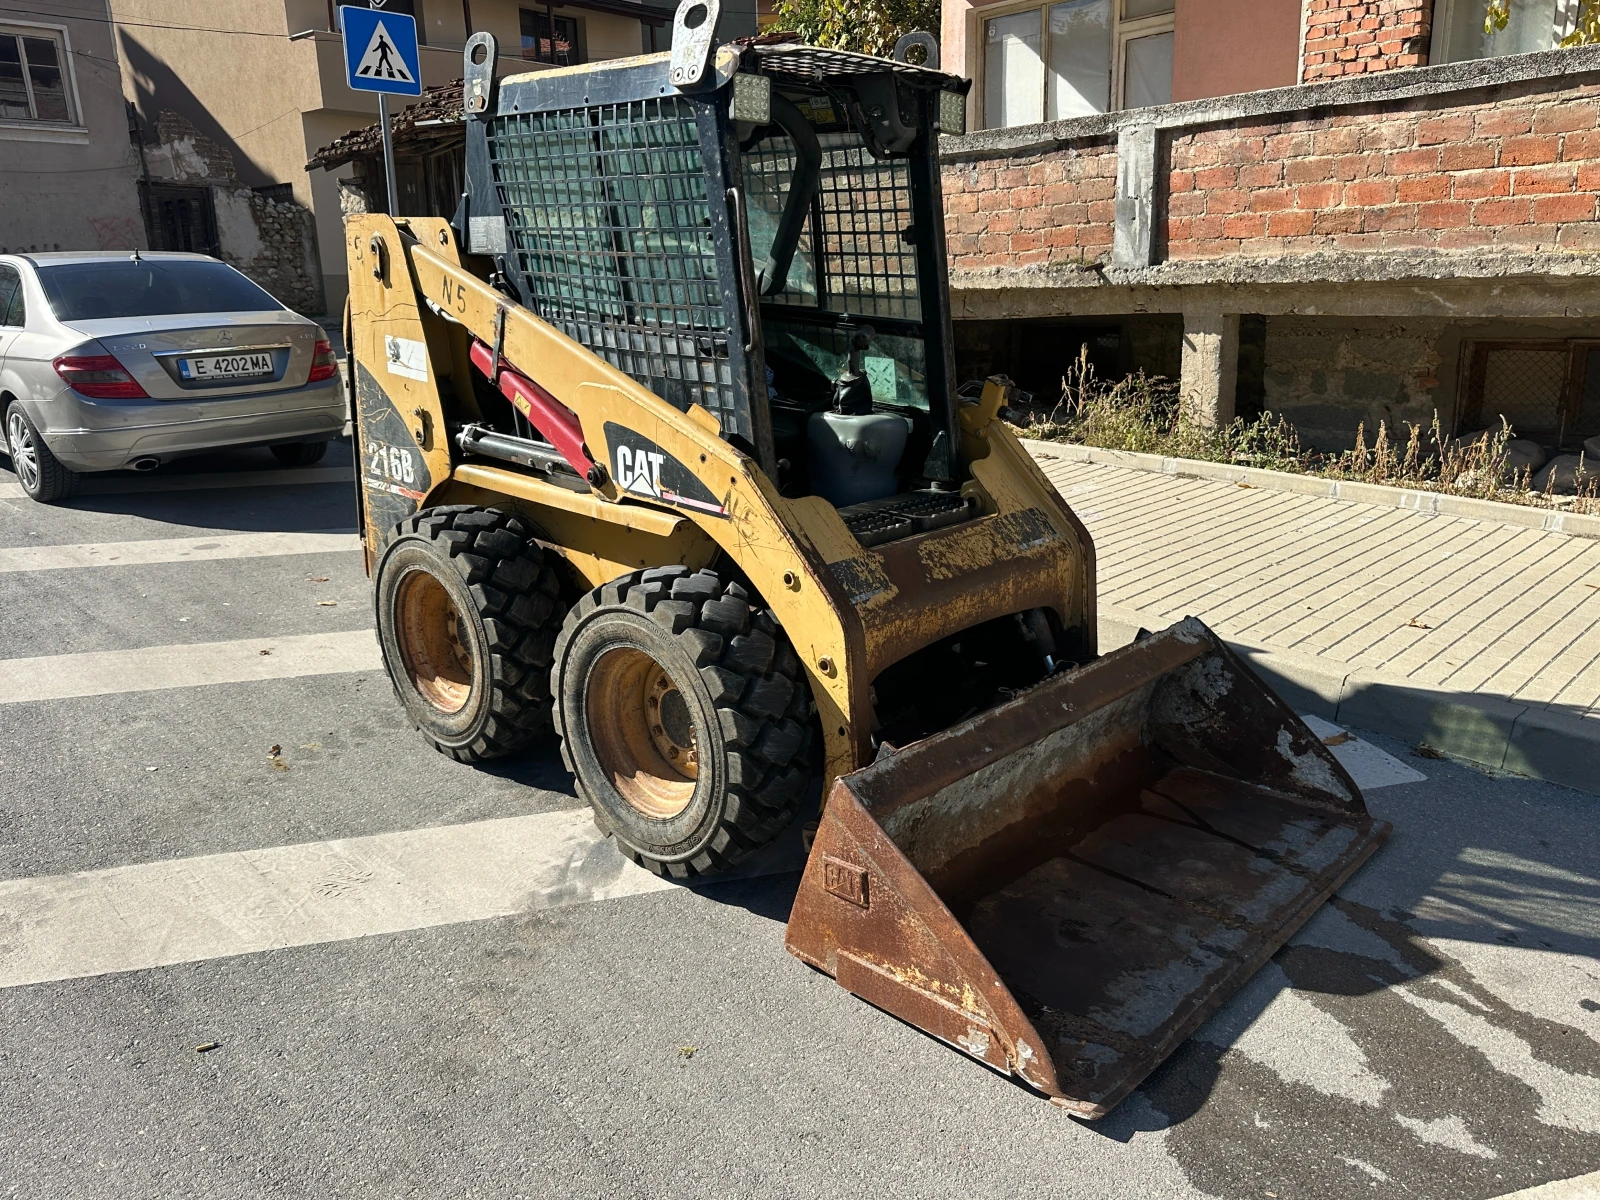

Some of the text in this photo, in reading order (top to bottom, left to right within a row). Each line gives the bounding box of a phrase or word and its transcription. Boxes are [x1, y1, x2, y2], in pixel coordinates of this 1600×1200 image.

[194, 360, 207, 375] E
[213, 357, 250, 373] 4202
[368, 441, 415, 484] 216B
[616, 444, 664, 498] CAT
